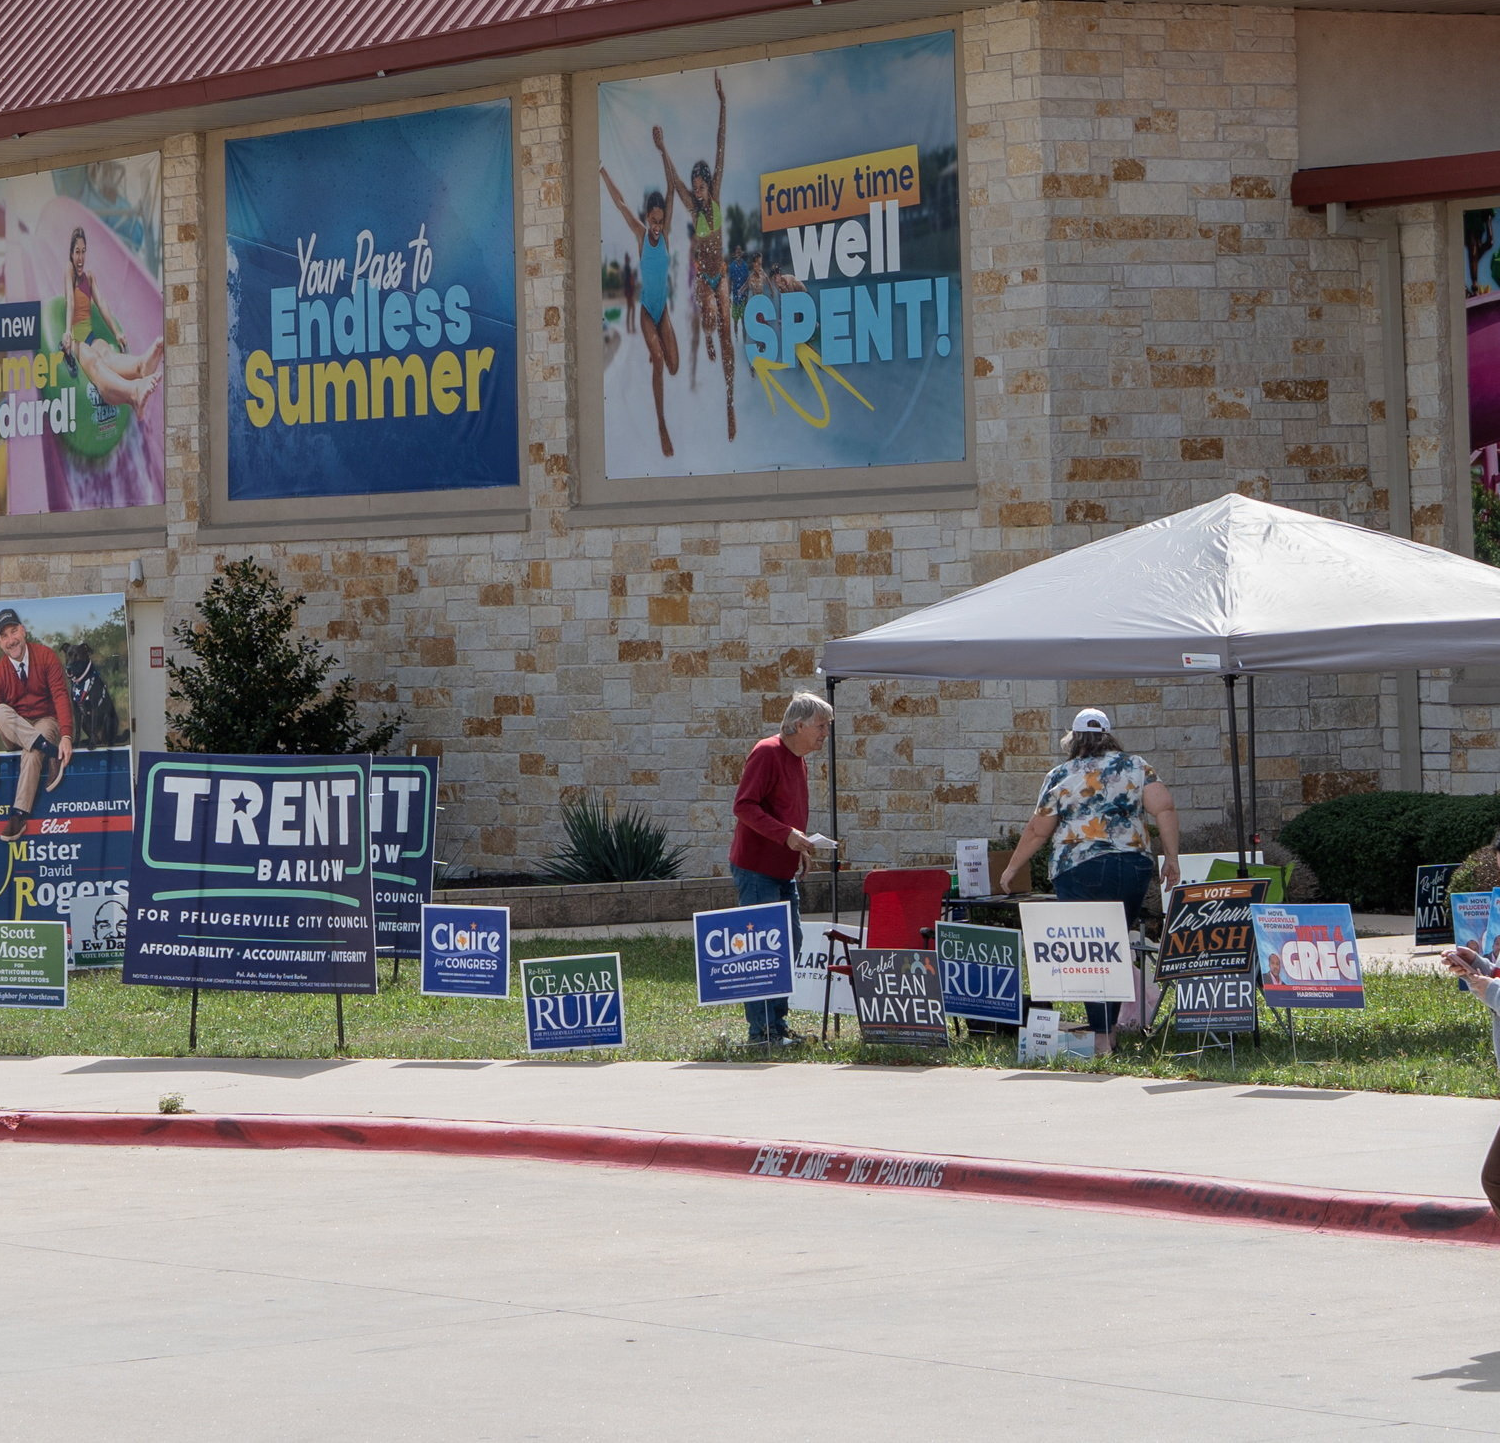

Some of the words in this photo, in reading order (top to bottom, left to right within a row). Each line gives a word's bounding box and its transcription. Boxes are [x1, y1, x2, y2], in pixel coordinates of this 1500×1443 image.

[765, 173, 845, 216] family
[853, 164, 915, 200] time
[786, 199, 901, 282] well
[297, 232, 345, 298] Your
[352, 229, 407, 295] Pass
[408, 223, 433, 293] to
[1, 316, 36, 338] new
[271, 278, 472, 361] Endless
[743, 276, 952, 369] SPENT!
[245, 347, 496, 428] Summer
[49, 800, 131, 813] AFFORDABILITY
[163, 776, 356, 846] TRENT
[40, 818, 72, 835] Elect
[8, 840, 82, 862] Mister
[39, 864, 72, 878] David
[257, 858, 344, 882] BARLOW
[13, 876, 130, 915] Rogers
[375, 891, 424, 903] COUNCIL
[1204, 887, 1232, 899] VOTE
[137, 908, 169, 922] FOR
[180, 911, 290, 927] PFLUGERVILLE
[297, 916, 323, 928] CITY
[327, 915, 369, 928] COUNCIL
[378, 920, 421, 932] INTEGRITY
[1417, 906, 1449, 928] MAY
[0, 926, 36, 939] Scott
[431, 923, 500, 952] Claire
[705, 927, 782, 958] Claire
[1046, 926, 1106, 939] CAITLIN
[1165, 926, 1250, 957] NASH
[81, 939, 104, 951] Ew
[139, 943, 235, 960] AFFORDABILITY
[242, 948, 327, 962] ACCOUNTABILITY
[330, 951, 368, 963] INTEGRITY
[941, 939, 1014, 967] CEASAR
[1033, 941, 1123, 963] ROURK
[1197, 949, 1209, 961] for
[434, 957, 444, 967] for
[444, 958, 497, 970] CONGRESS
[710, 966, 721, 977] for
[722, 958, 780, 975] CONGRESS
[856, 952, 897, 981] Re-elect
[1052, 966, 1062, 976] for
[1161, 962, 1187, 972] TRAVIS
[1188, 959, 1219, 969] COUNTY
[1221, 957, 1247, 966] CLERK
[1282, 941, 1358, 981] GREG
[529, 971, 615, 996] CEASAR
[874, 973, 927, 996] JEAN
[941, 959, 1017, 1002] RUIZ
[18, 993, 28, 1002] for
[1177, 981, 1254, 1011] MAYER
[531, 992, 618, 1031] RUIZ
[859, 997, 945, 1026] MAYER
[749, 1146, 793, 1176] FIRE
[787, 1151, 835, 1181] LANE
[846, 1157, 876, 1183] NO
[874, 1158, 949, 1188] PARKING
